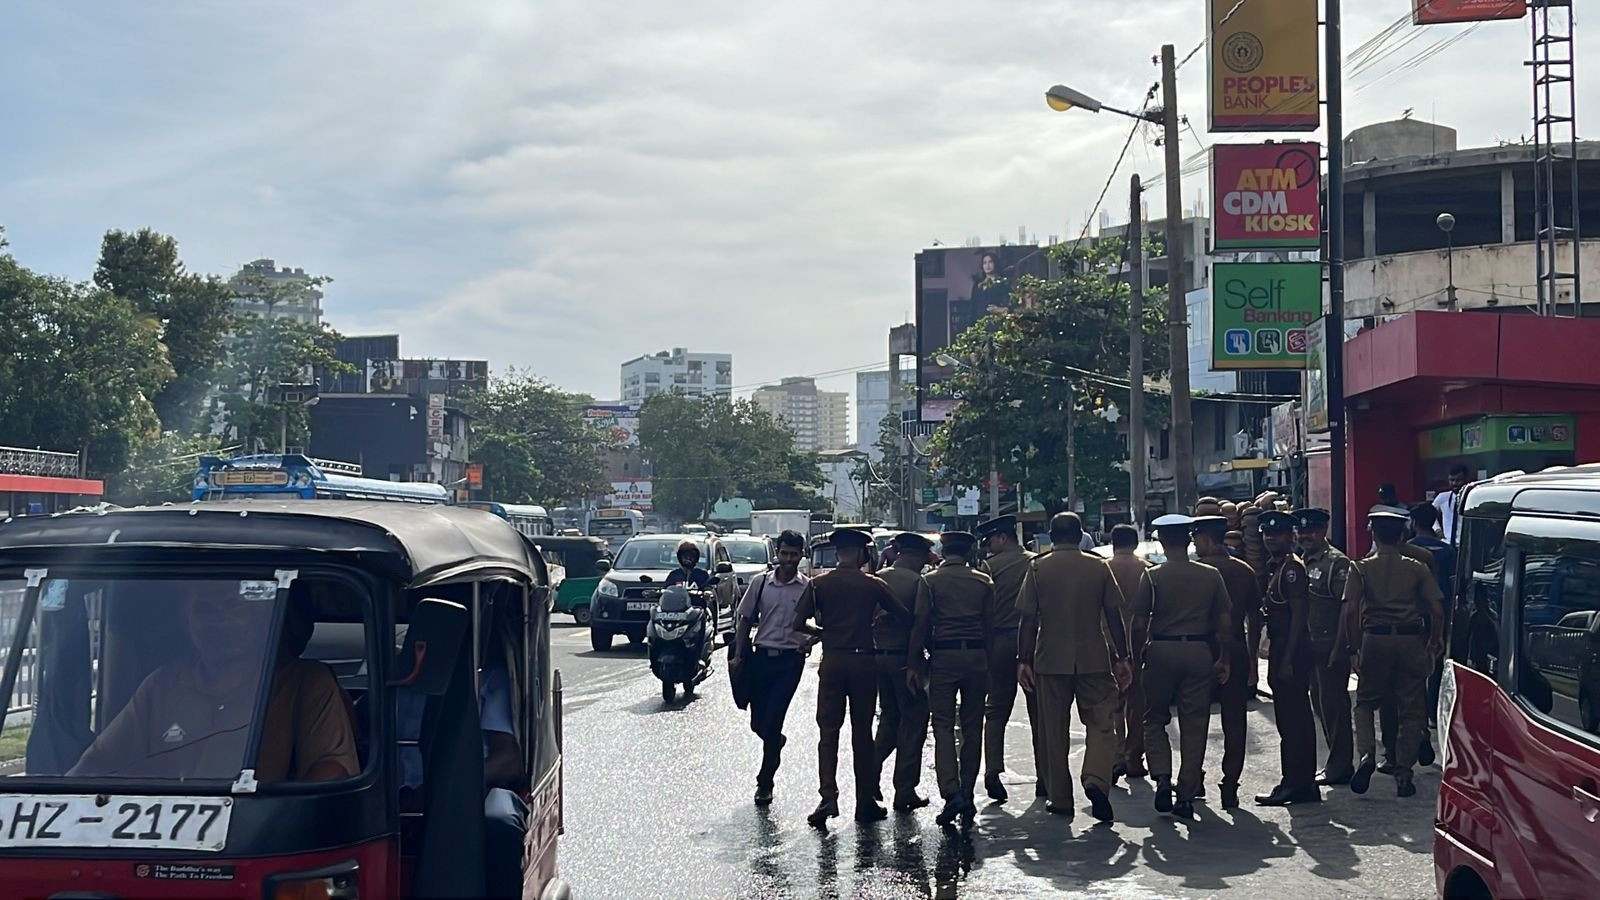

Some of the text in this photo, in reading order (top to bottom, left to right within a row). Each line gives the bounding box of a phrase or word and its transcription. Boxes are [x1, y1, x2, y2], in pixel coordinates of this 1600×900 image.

[1223, 95, 1270, 110] BANK
[1236, 168, 1297, 191] ATM
[1223, 191, 1288, 215] CDM
[1245, 215, 1314, 232] KIOSK
[1224, 279, 1286, 309] Self
[1243, 309, 1313, 325] Banking
[8, 802, 69, 839] HZ
[112, 802, 223, 841] 2177
